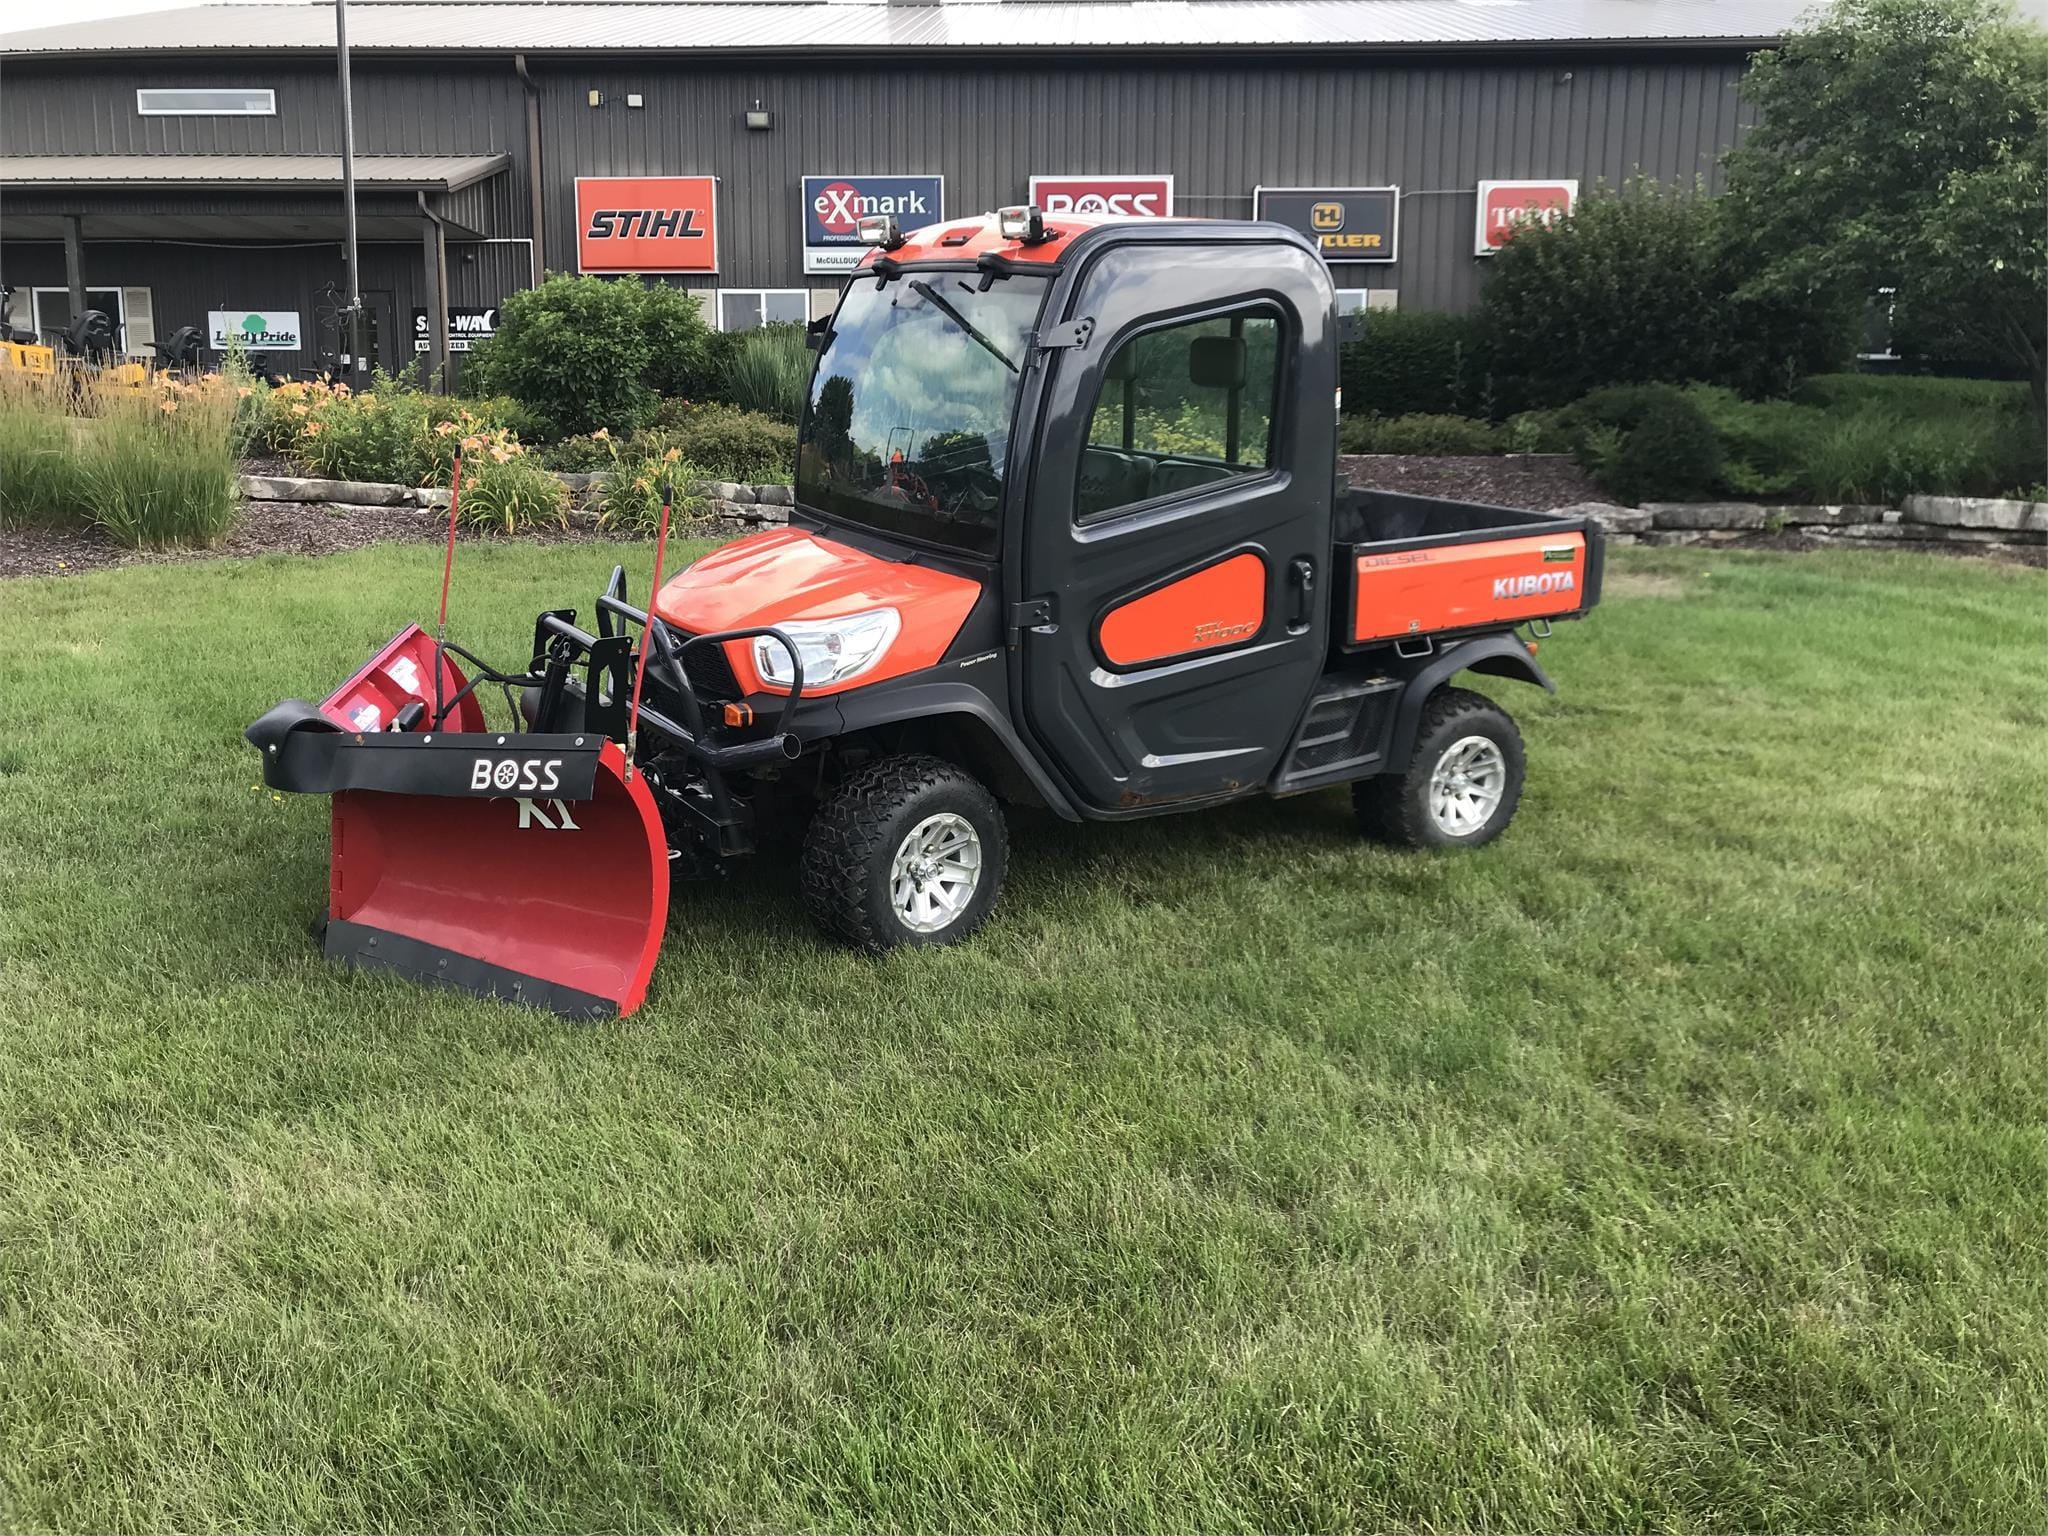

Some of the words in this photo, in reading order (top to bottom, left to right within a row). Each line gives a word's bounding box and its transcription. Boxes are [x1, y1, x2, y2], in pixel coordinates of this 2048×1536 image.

[814, 190, 926, 224] eXmark
[586, 208, 705, 239] STIHL
[1321, 234, 1381, 248] TLER
[415, 310, 495, 331] S-WAY
[216, 331, 249, 341] Lnd
[260, 331, 296, 342] Pride
[1365, 553, 1436, 568] DIESEL
[1493, 571, 1574, 600] KUBOTA
[471, 759, 562, 791] BOSS
